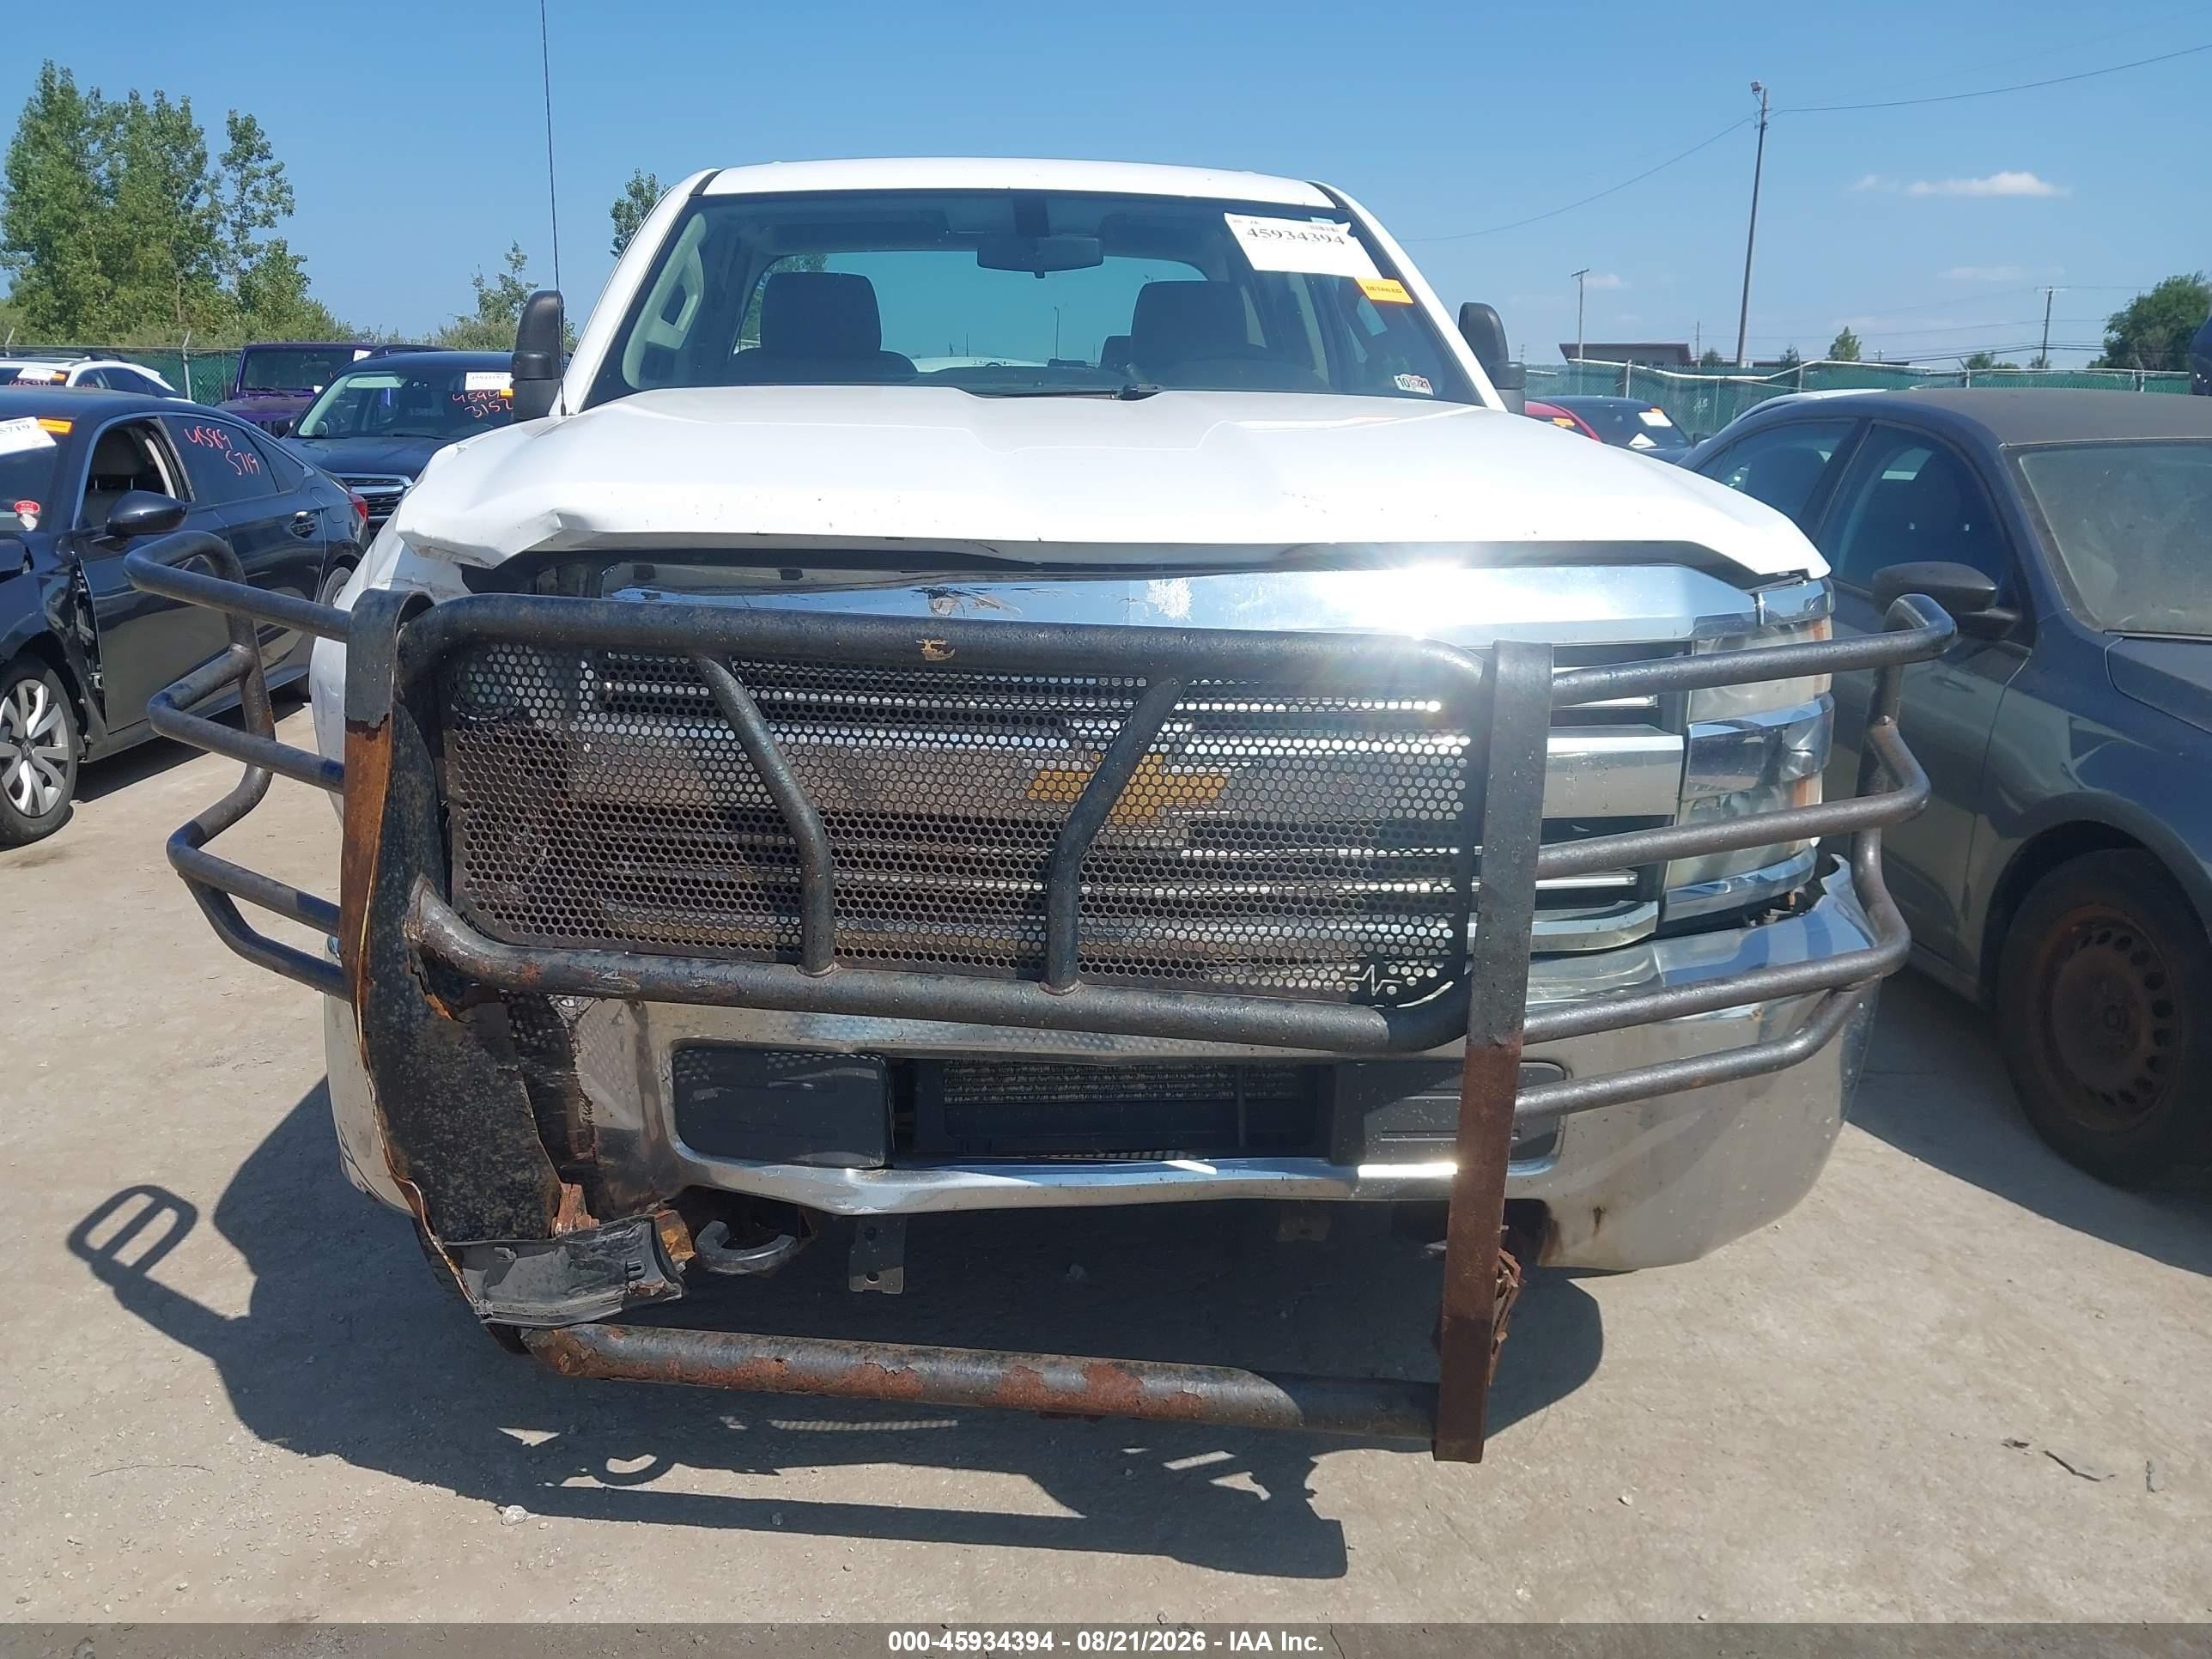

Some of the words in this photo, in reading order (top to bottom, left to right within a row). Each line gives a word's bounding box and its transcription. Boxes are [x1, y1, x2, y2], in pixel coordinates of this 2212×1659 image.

[1247, 227, 1346, 246] 45934394
[464, 398, 514, 418] 3152
[184, 425, 234, 450] 4589
[225, 449, 261, 476] 5719
